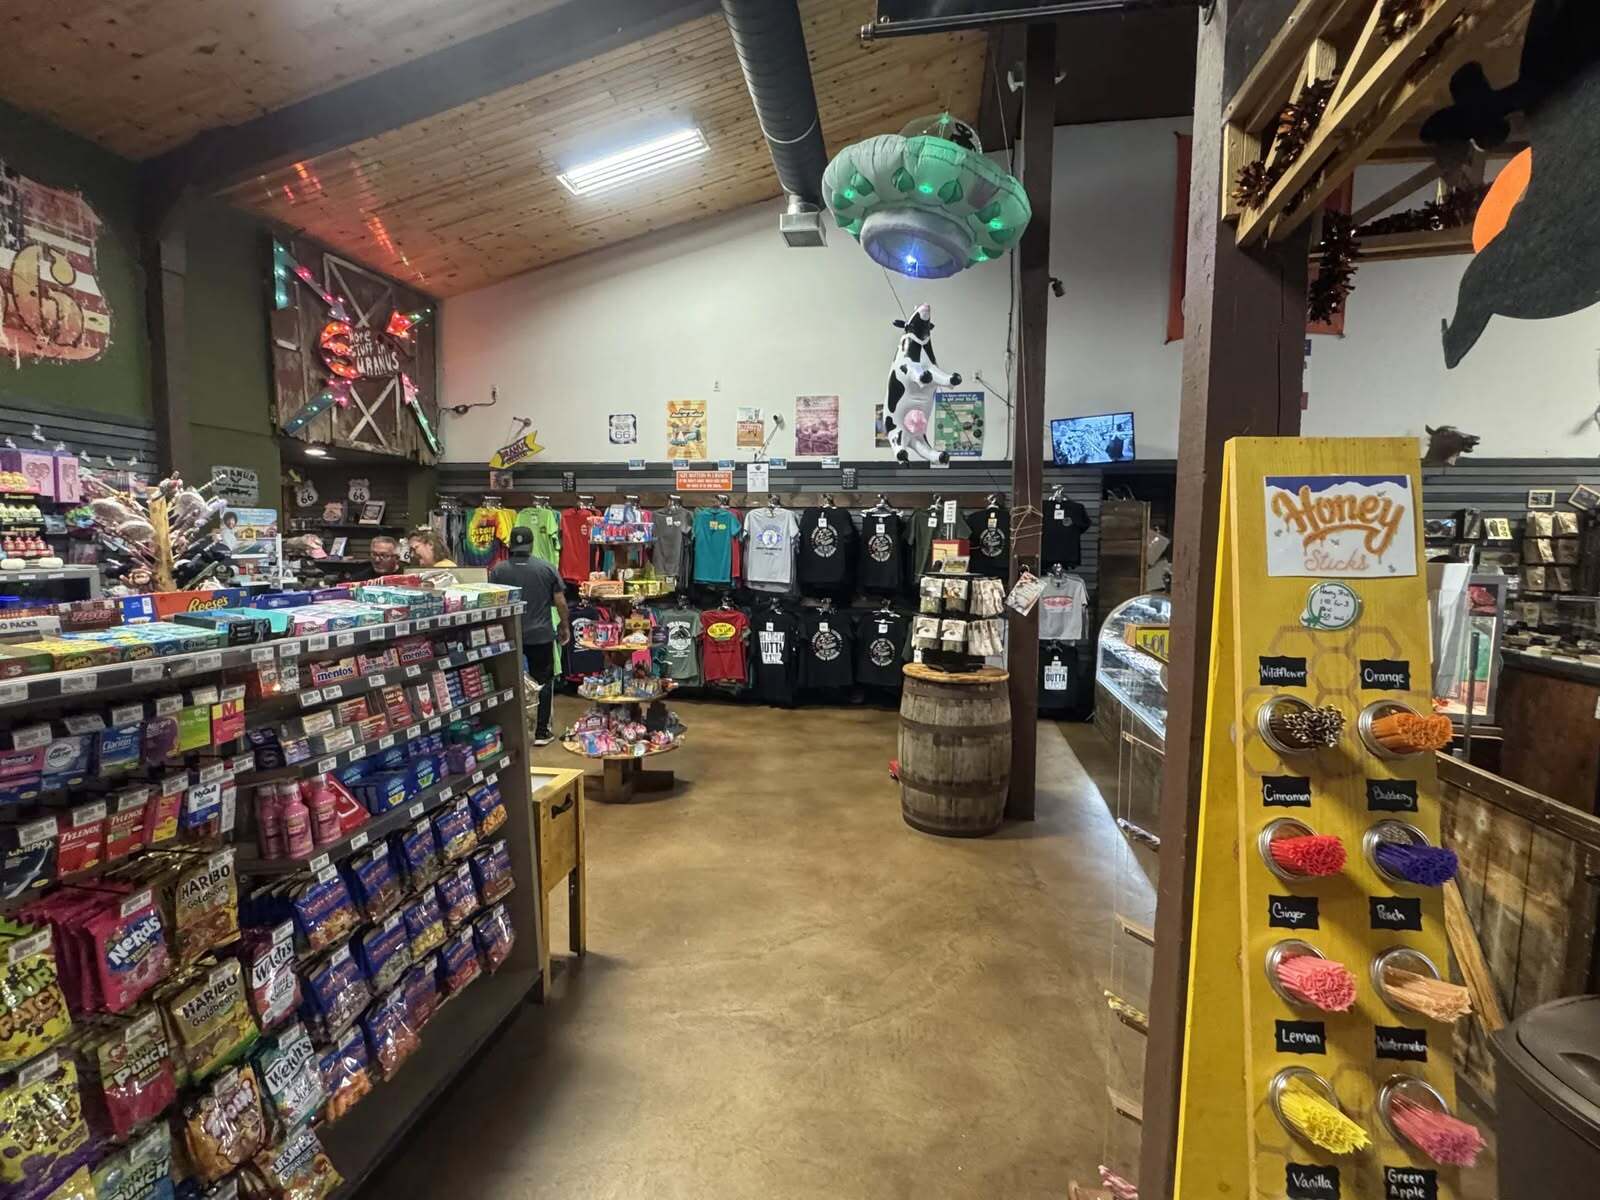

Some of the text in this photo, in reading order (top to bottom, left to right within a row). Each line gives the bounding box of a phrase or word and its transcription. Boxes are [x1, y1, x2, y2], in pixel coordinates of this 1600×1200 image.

[356, 351, 400, 376] URANUS
[615, 430, 631, 439] 66
[301, 494, 314, 504] 66
[353, 491, 365, 500] 66
[1271, 485, 1405, 555] Honey
[402, 648, 430, 661] mentos
[317, 666, 353, 682] mentos
[1364, 668, 1405, 688] Orange
[1263, 784, 1310, 801] Cinnamon
[181, 864, 230, 899] HARIBO
[1272, 902, 1306, 923] Ginger
[108, 916, 161, 966] Nerds
[181, 973, 238, 1020] HARIBO
[1281, 1028, 1320, 1045] Lemon
[113, 1042, 168, 1087] PUNCH
[1292, 1172, 1333, 1189] Vanilla
[1387, 1169, 1424, 1184] Green
